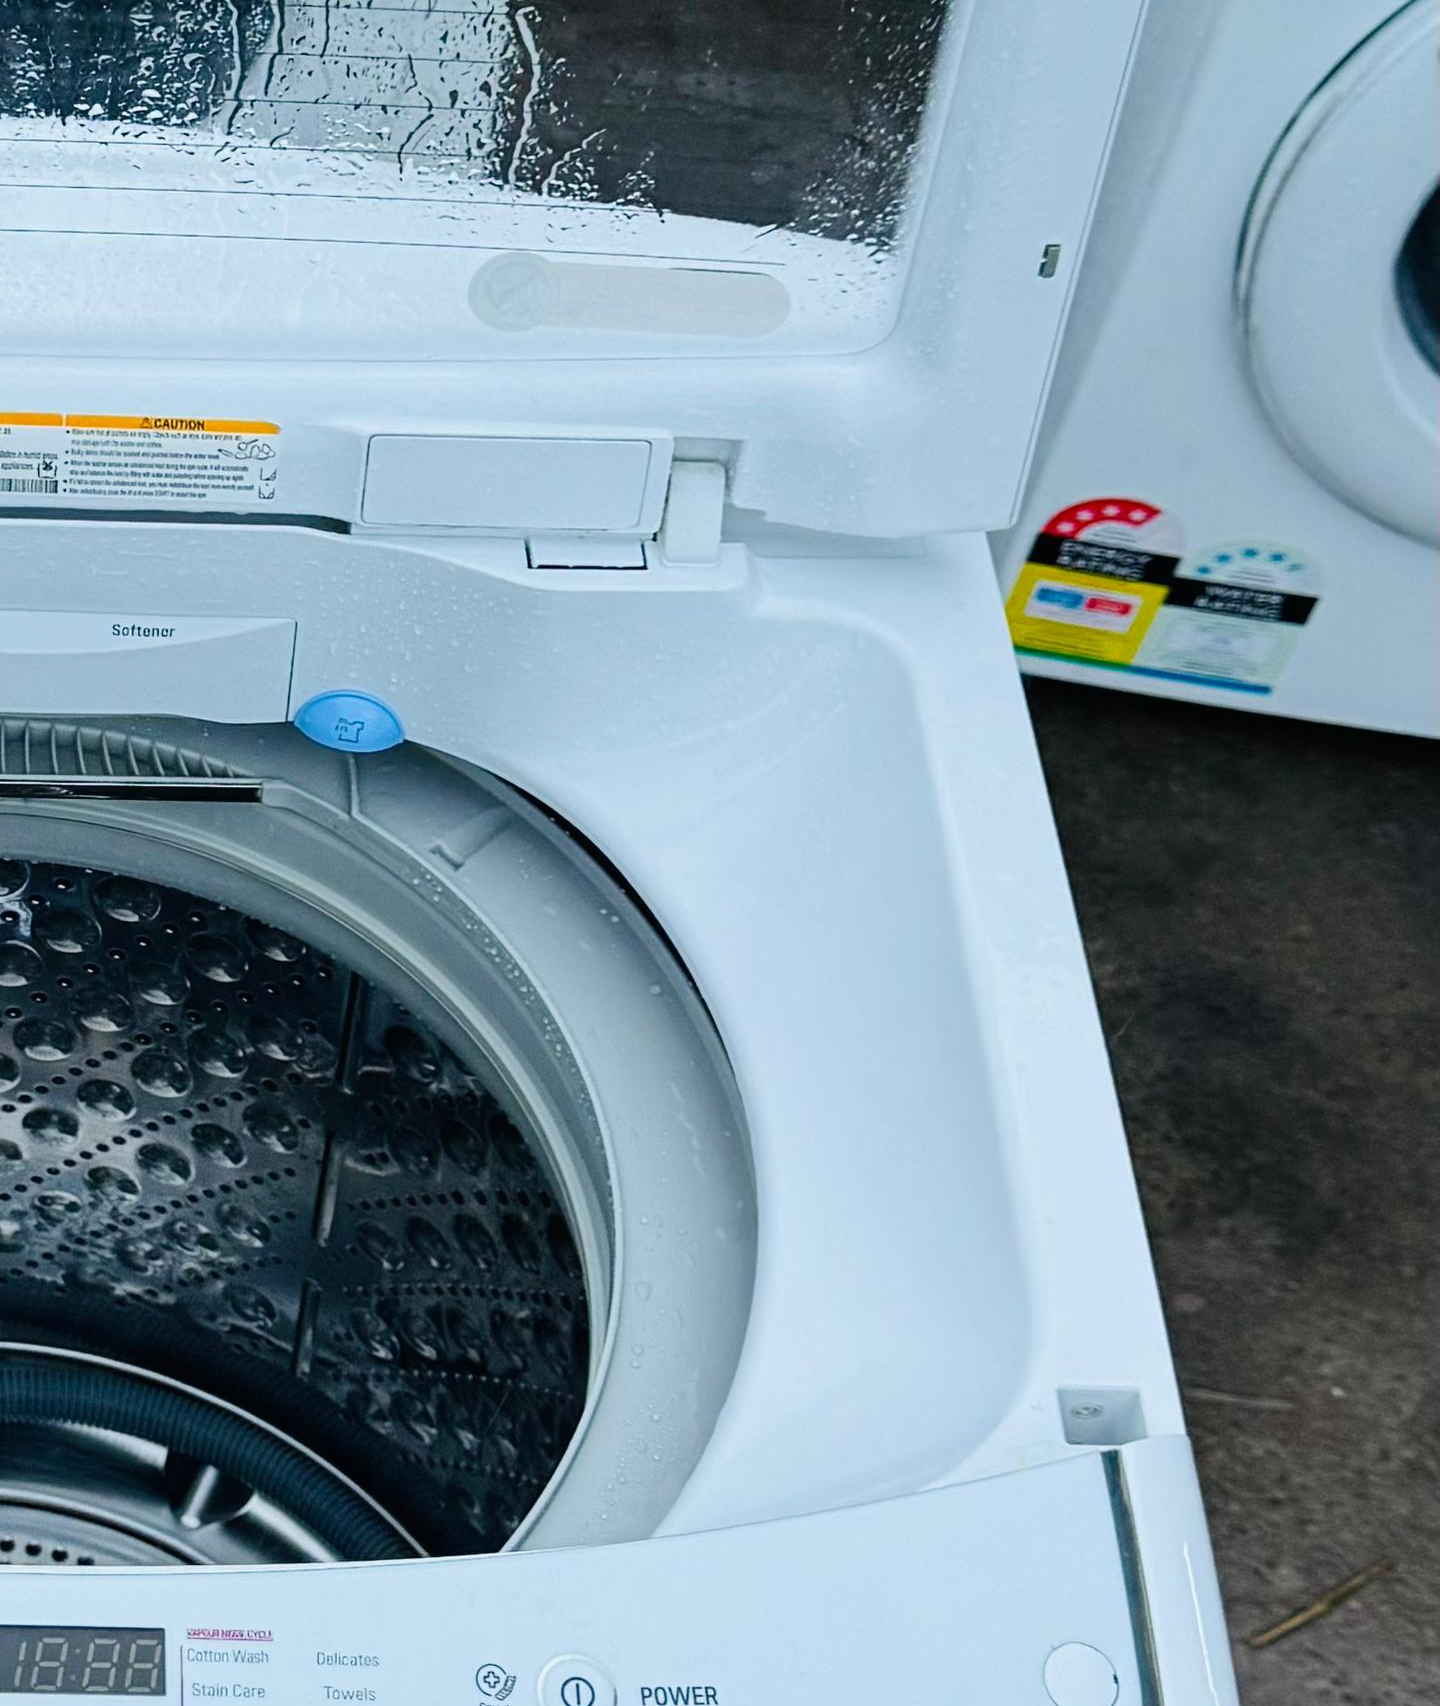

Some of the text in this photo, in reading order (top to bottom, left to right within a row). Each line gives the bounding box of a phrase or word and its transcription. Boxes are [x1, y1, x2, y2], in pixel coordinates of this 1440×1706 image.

[153, 418, 205, 431] CAUTION
[111, 623, 176, 638] Softener
[187, 1648, 269, 1663] Cotton Wash
[316, 1651, 380, 1668] Delicates
[191, 1682, 266, 1699] Stain Care
[323, 1685, 377, 1702] Towels
[640, 1685, 719, 1706] POWER
